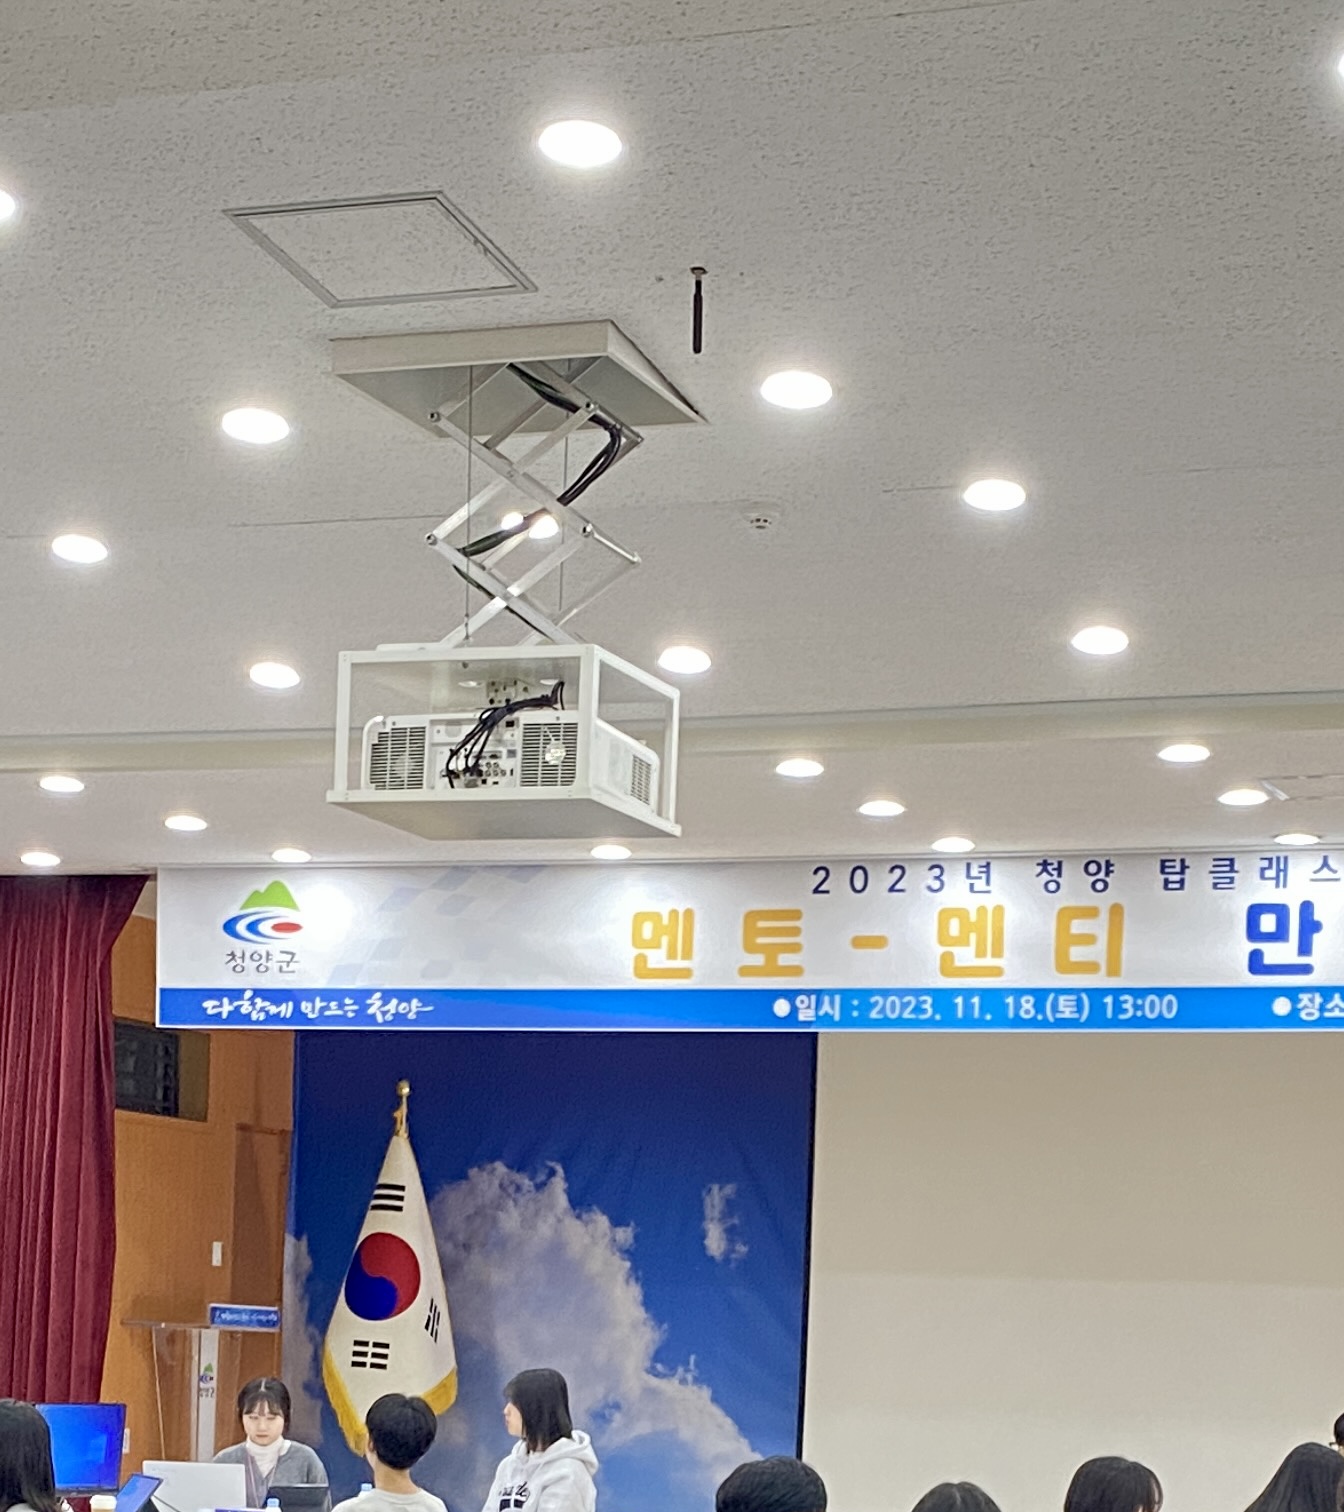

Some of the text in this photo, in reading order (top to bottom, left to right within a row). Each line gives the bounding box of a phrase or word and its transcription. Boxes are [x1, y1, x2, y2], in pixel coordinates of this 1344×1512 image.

[811, 860, 994, 895] 2023년
[1035, 858, 1115, 894] 청양
[1159, 854, 1342, 892] 탑클래스
[224, 949, 300, 975] 청양군
[201, 988, 435, 1024] 다함께 만드는 청양
[794, 994, 841, 1023] 일시
[869, 995, 942, 1022] 2023.
[954, 995, 992, 1021] 11.
[1004, 993, 1090, 1024] 18.(토)
[1102, 993, 1178, 1021] 13:00
